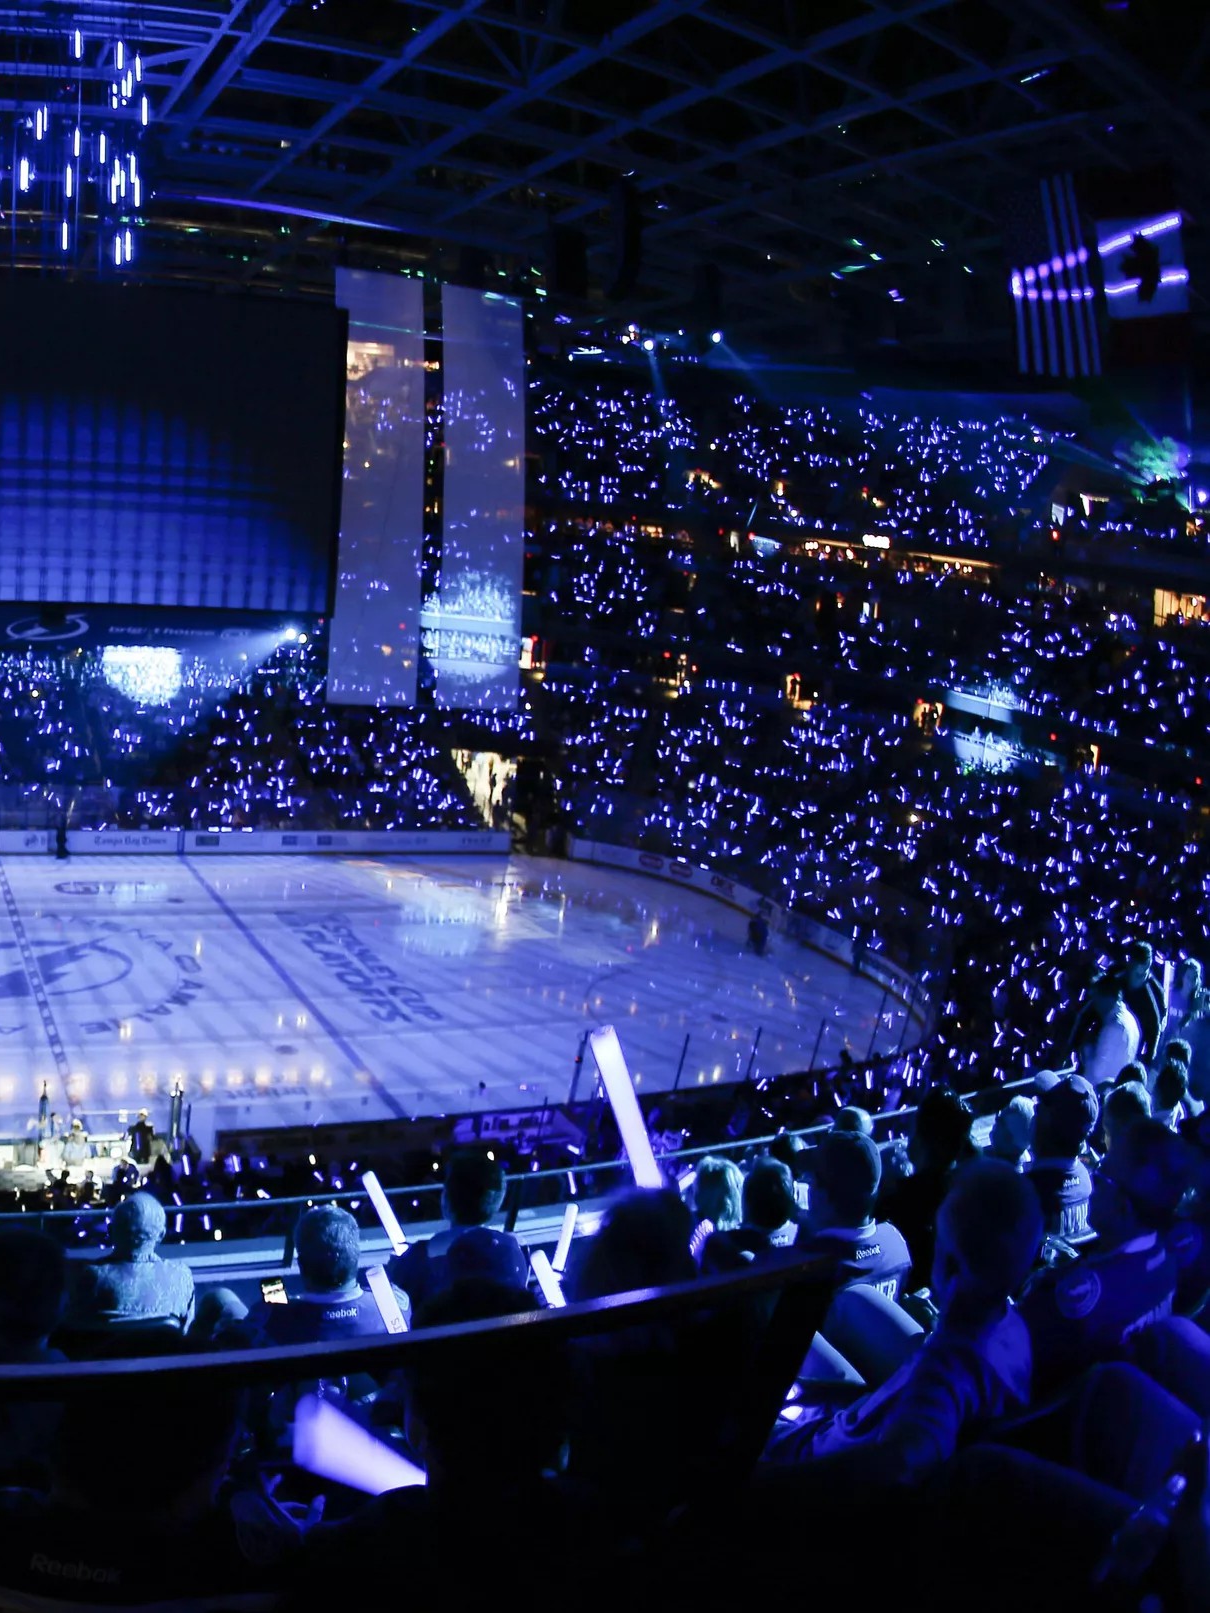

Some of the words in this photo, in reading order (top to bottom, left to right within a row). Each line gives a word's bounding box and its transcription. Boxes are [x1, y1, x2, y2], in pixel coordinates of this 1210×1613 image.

[94, 835, 123, 847] Tampa
[142, 835, 167, 845] Times
[291, 928, 413, 1023] PLAYOFFS
[387, 984, 444, 1021] CUP
[855, 1244, 881, 1261] Reebok
[326, 1307, 357, 1319] eebok
[29, 1551, 123, 1586] Reebok
